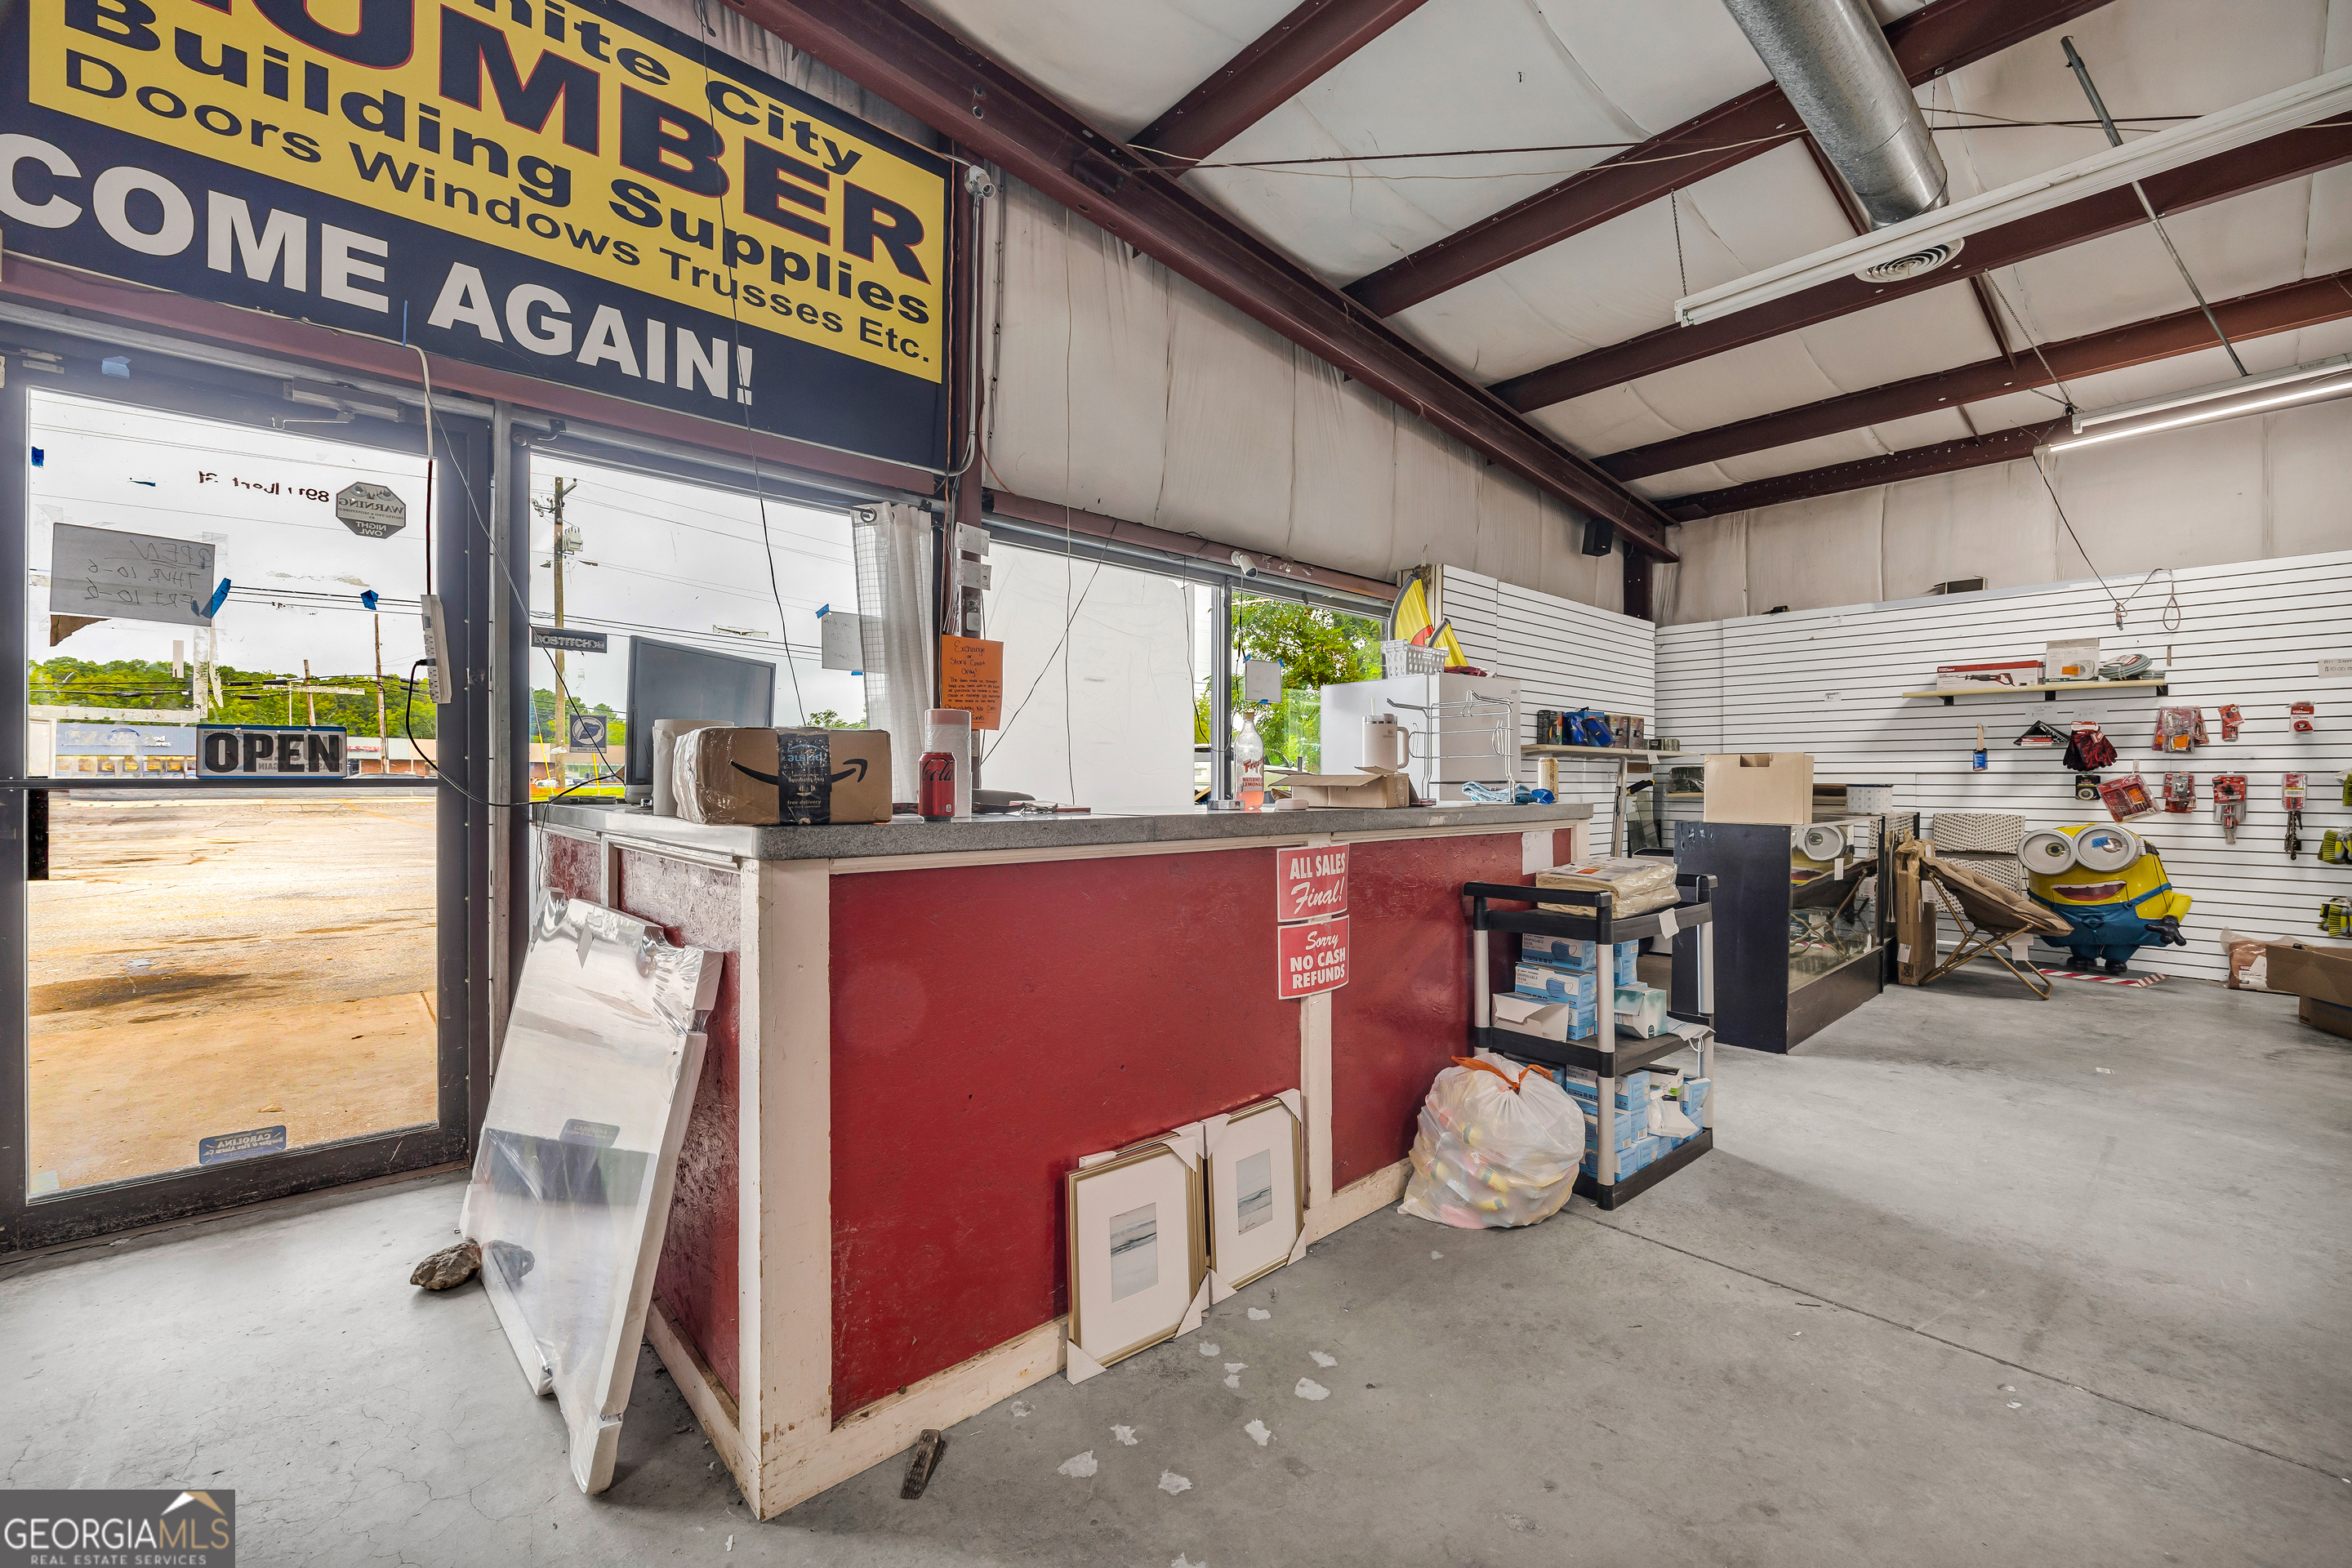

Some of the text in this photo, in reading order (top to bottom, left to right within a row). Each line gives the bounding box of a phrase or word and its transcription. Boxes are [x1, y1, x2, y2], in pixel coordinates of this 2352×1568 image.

[194, 0, 932, 285] UMBER
[705, 80, 862, 176] City
[64, 0, 929, 325] Building Supplies
[65, 48, 929, 363] Doors Windows Trusses Etc.
[0, 133, 753, 406] COME AGAIN!
[954, 640, 986, 656] Exchange
[205, 732, 340, 773] OPEN
[787, 751, 823, 768] prime
[920, 757, 955, 782] Cola
[1290, 852, 1346, 880] ALL SALES
[1290, 875, 1345, 915] Final!
[1305, 930, 1339, 951] Sorry
[1290, 947, 1346, 973] NO CASH
[1292, 963, 1345, 990] REFUNDS
